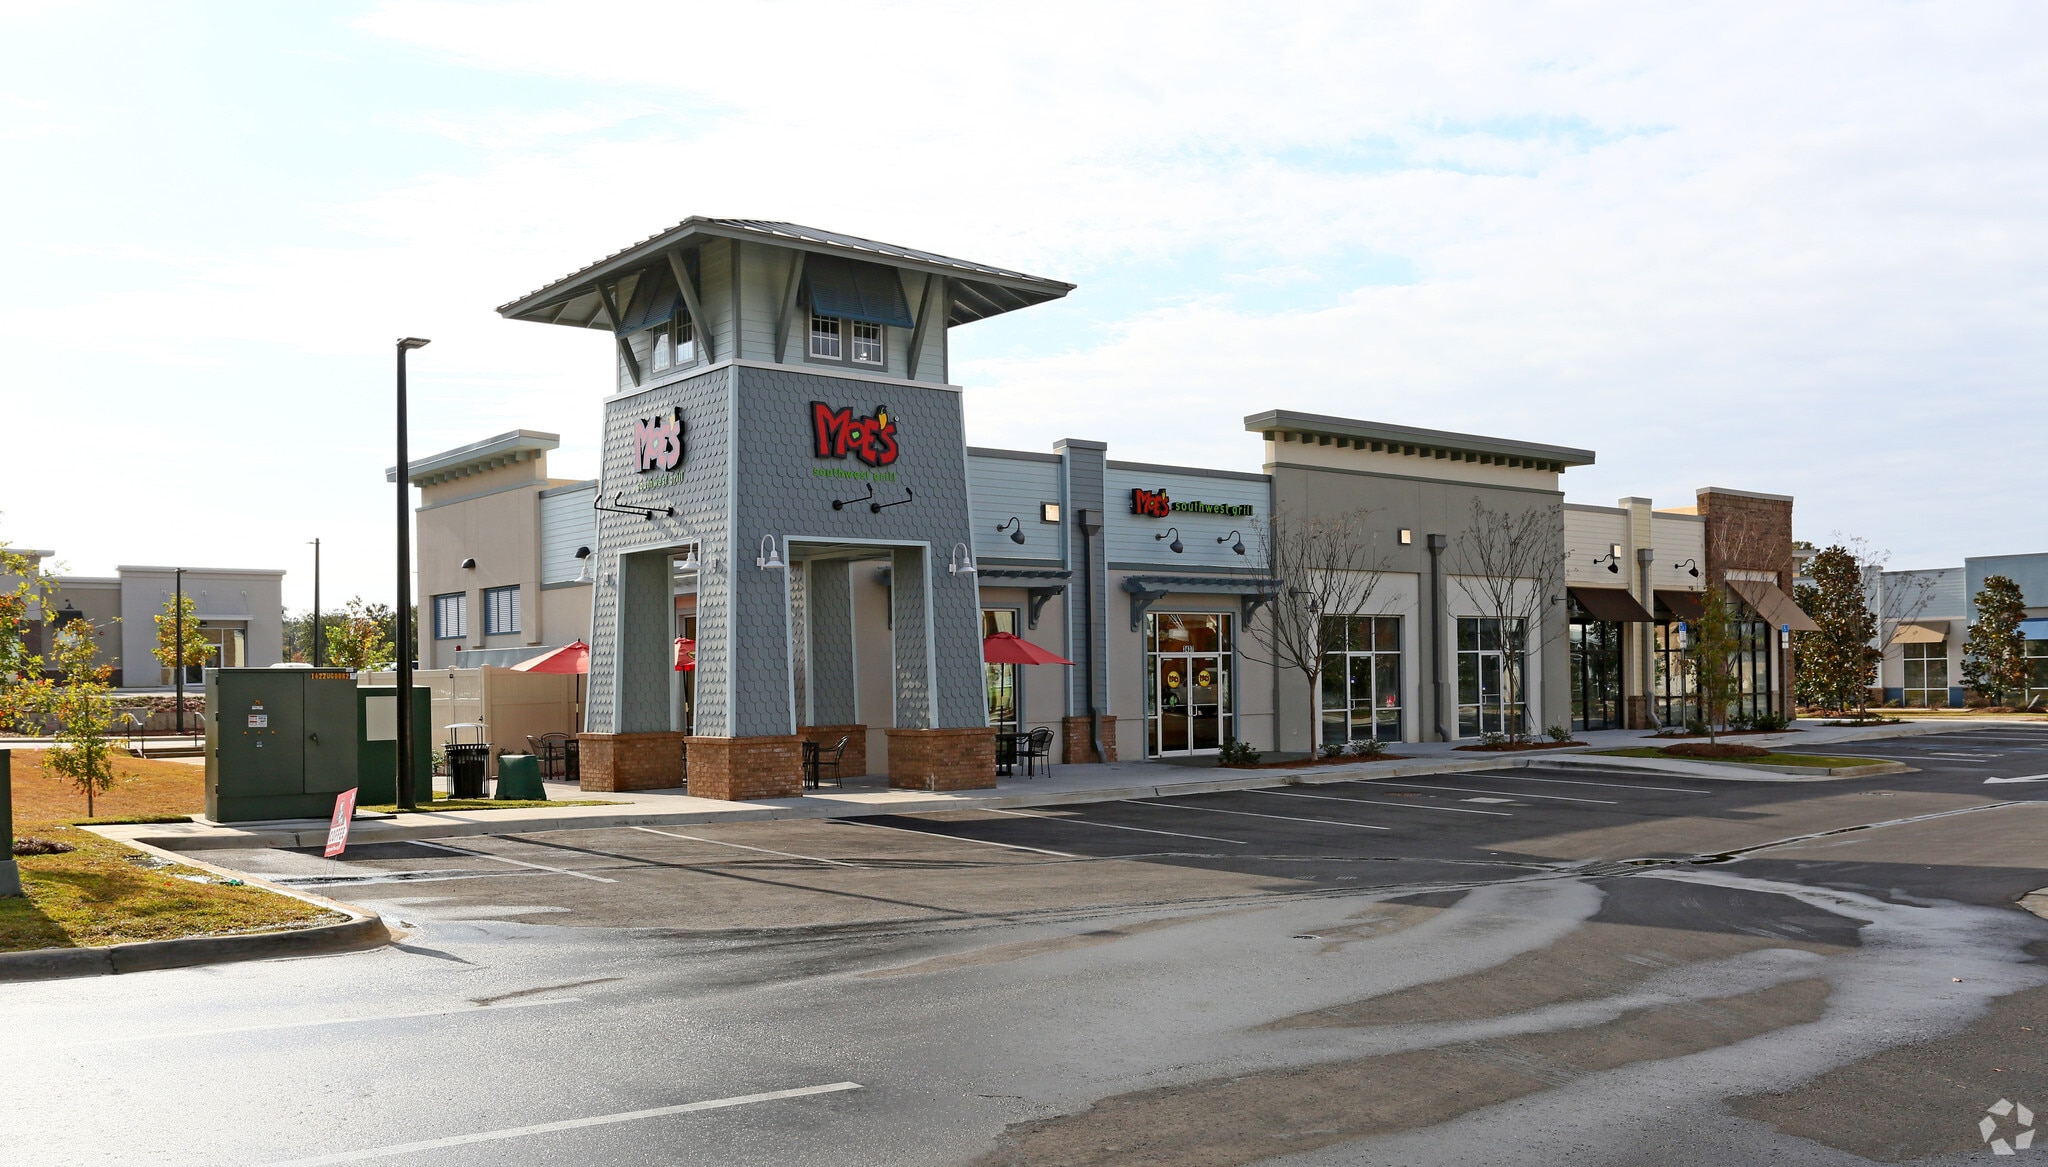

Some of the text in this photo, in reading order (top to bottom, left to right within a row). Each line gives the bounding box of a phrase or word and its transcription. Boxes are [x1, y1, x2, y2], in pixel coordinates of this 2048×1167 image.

[813, 467, 897, 484] southwest grill
[1174, 501, 1229, 515] southwest
[1232, 504, 1254, 517] grill
